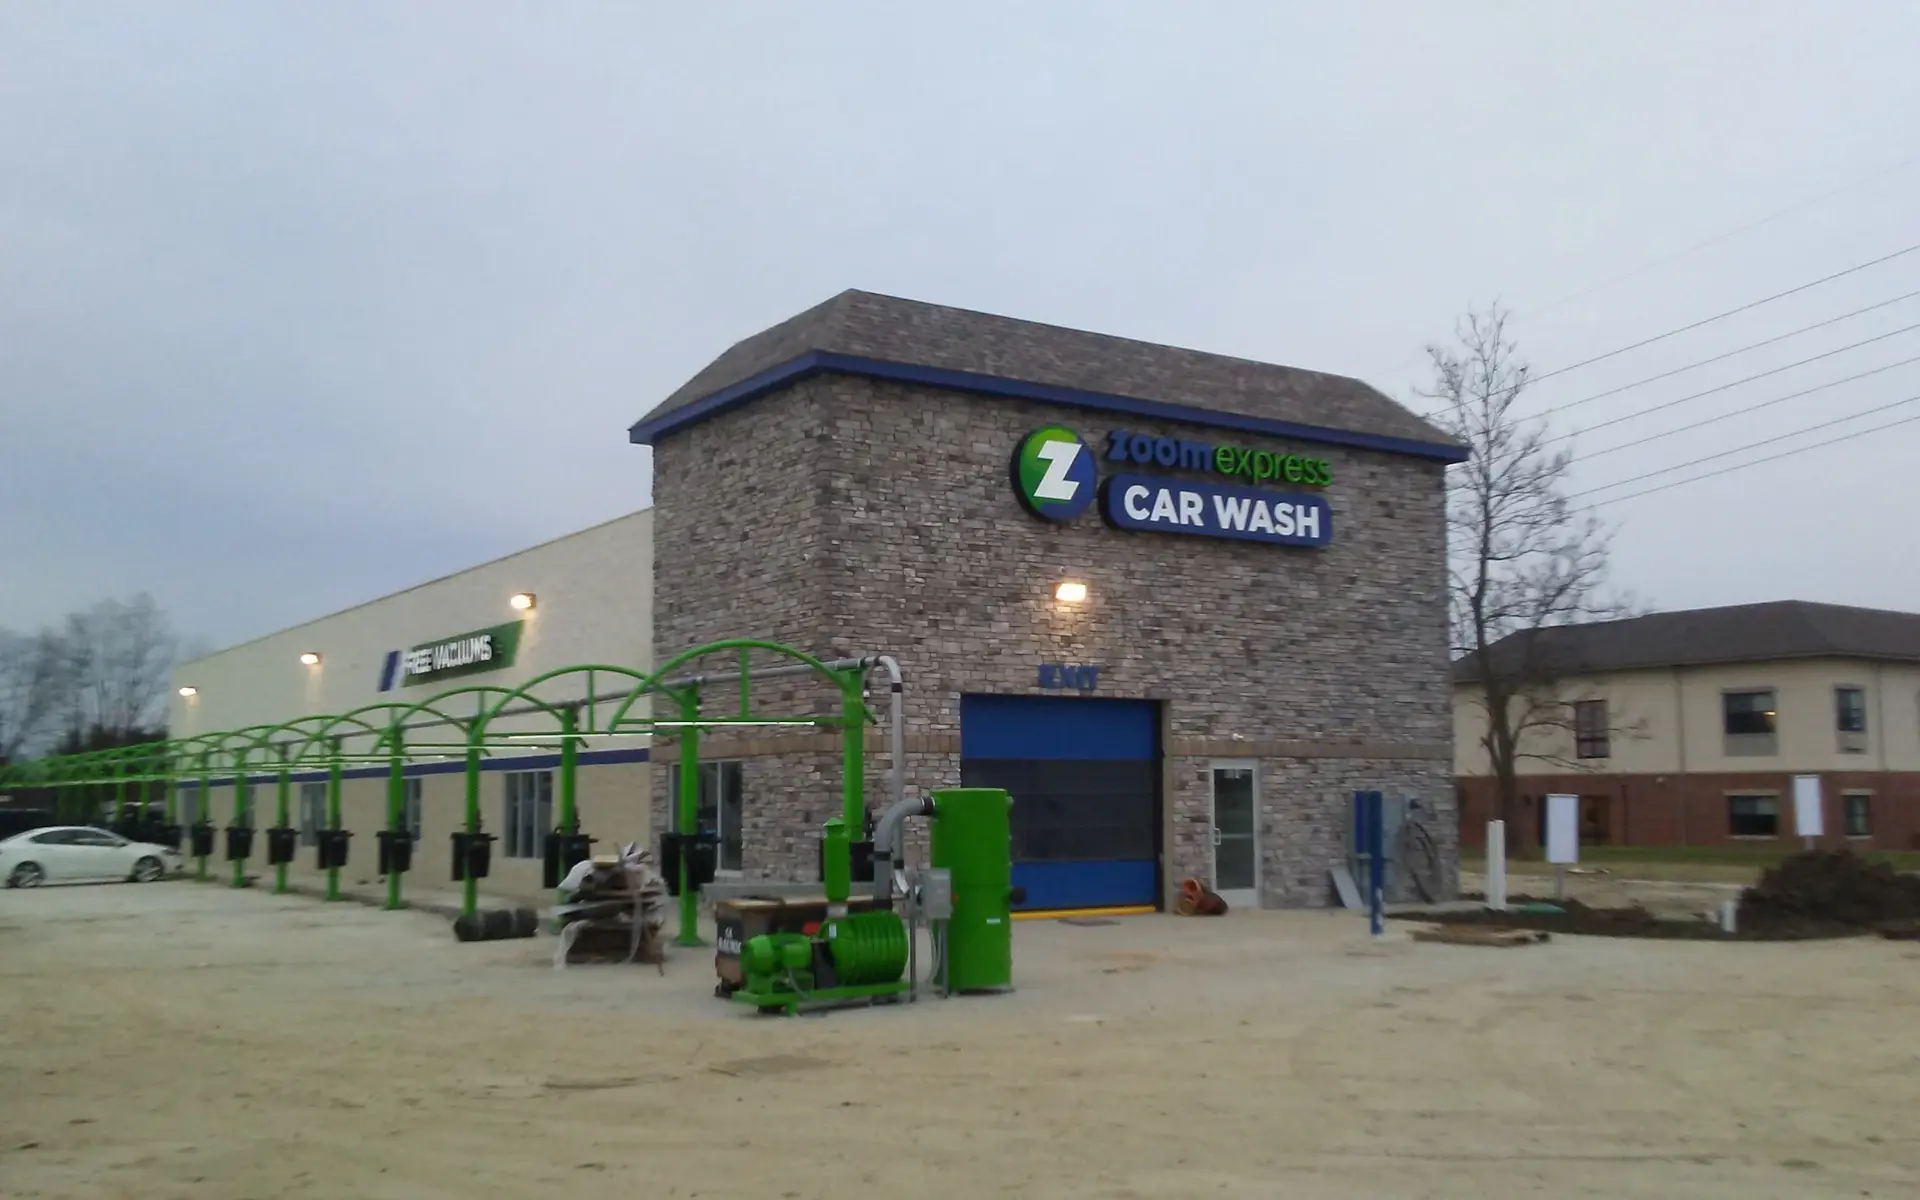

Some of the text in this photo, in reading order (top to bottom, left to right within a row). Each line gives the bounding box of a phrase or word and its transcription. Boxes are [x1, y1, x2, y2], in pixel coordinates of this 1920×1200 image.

[1034, 440, 1082, 500] Z
[1124, 485, 1320, 538] CAR WASH
[402, 635, 492, 676] FREE VACUUMS
